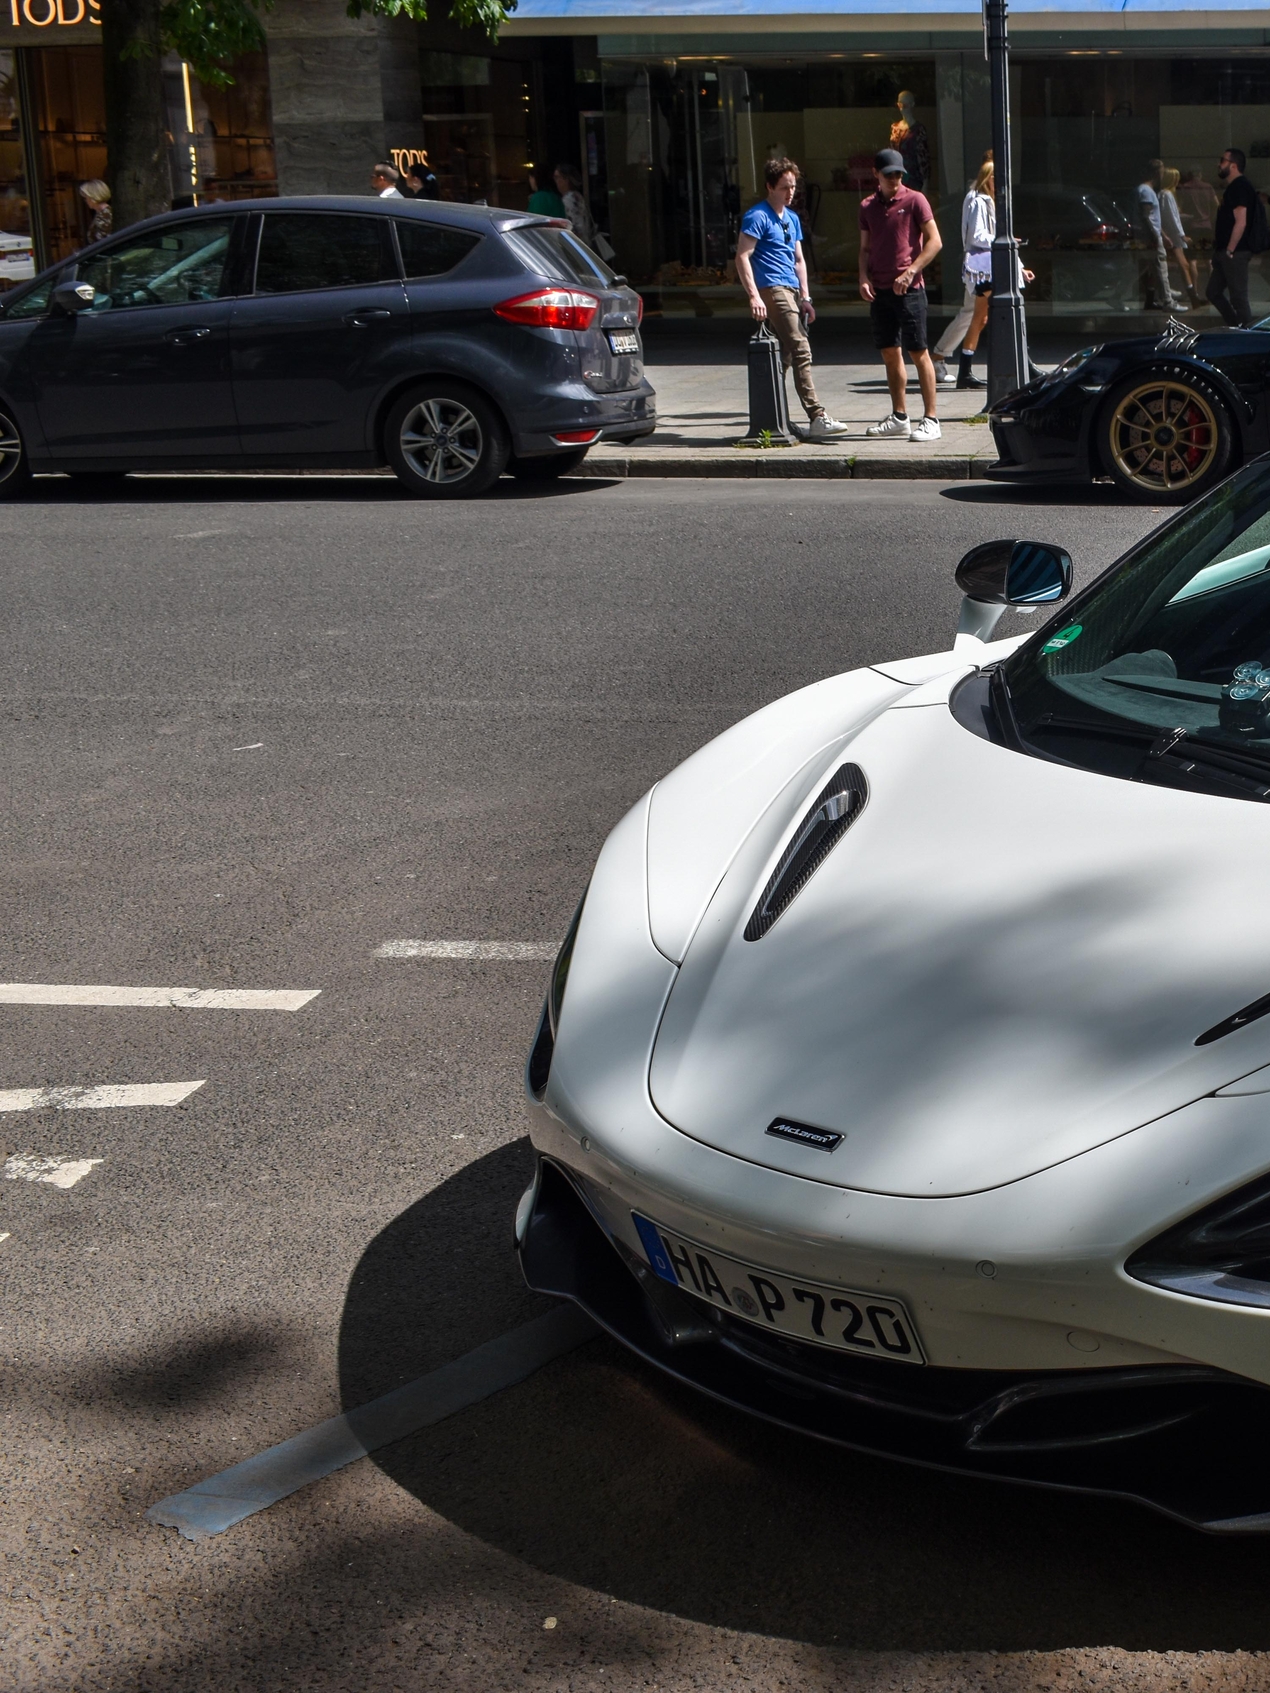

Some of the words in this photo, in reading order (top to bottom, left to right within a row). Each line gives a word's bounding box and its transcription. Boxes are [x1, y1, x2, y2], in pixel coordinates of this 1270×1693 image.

[773, 1124, 828, 1143] McLaren
[655, 1255, 666, 1270] D
[661, 1234, 732, 1306] HA
[747, 1273, 785, 1323] P
[792, 1286, 912, 1355] 720
